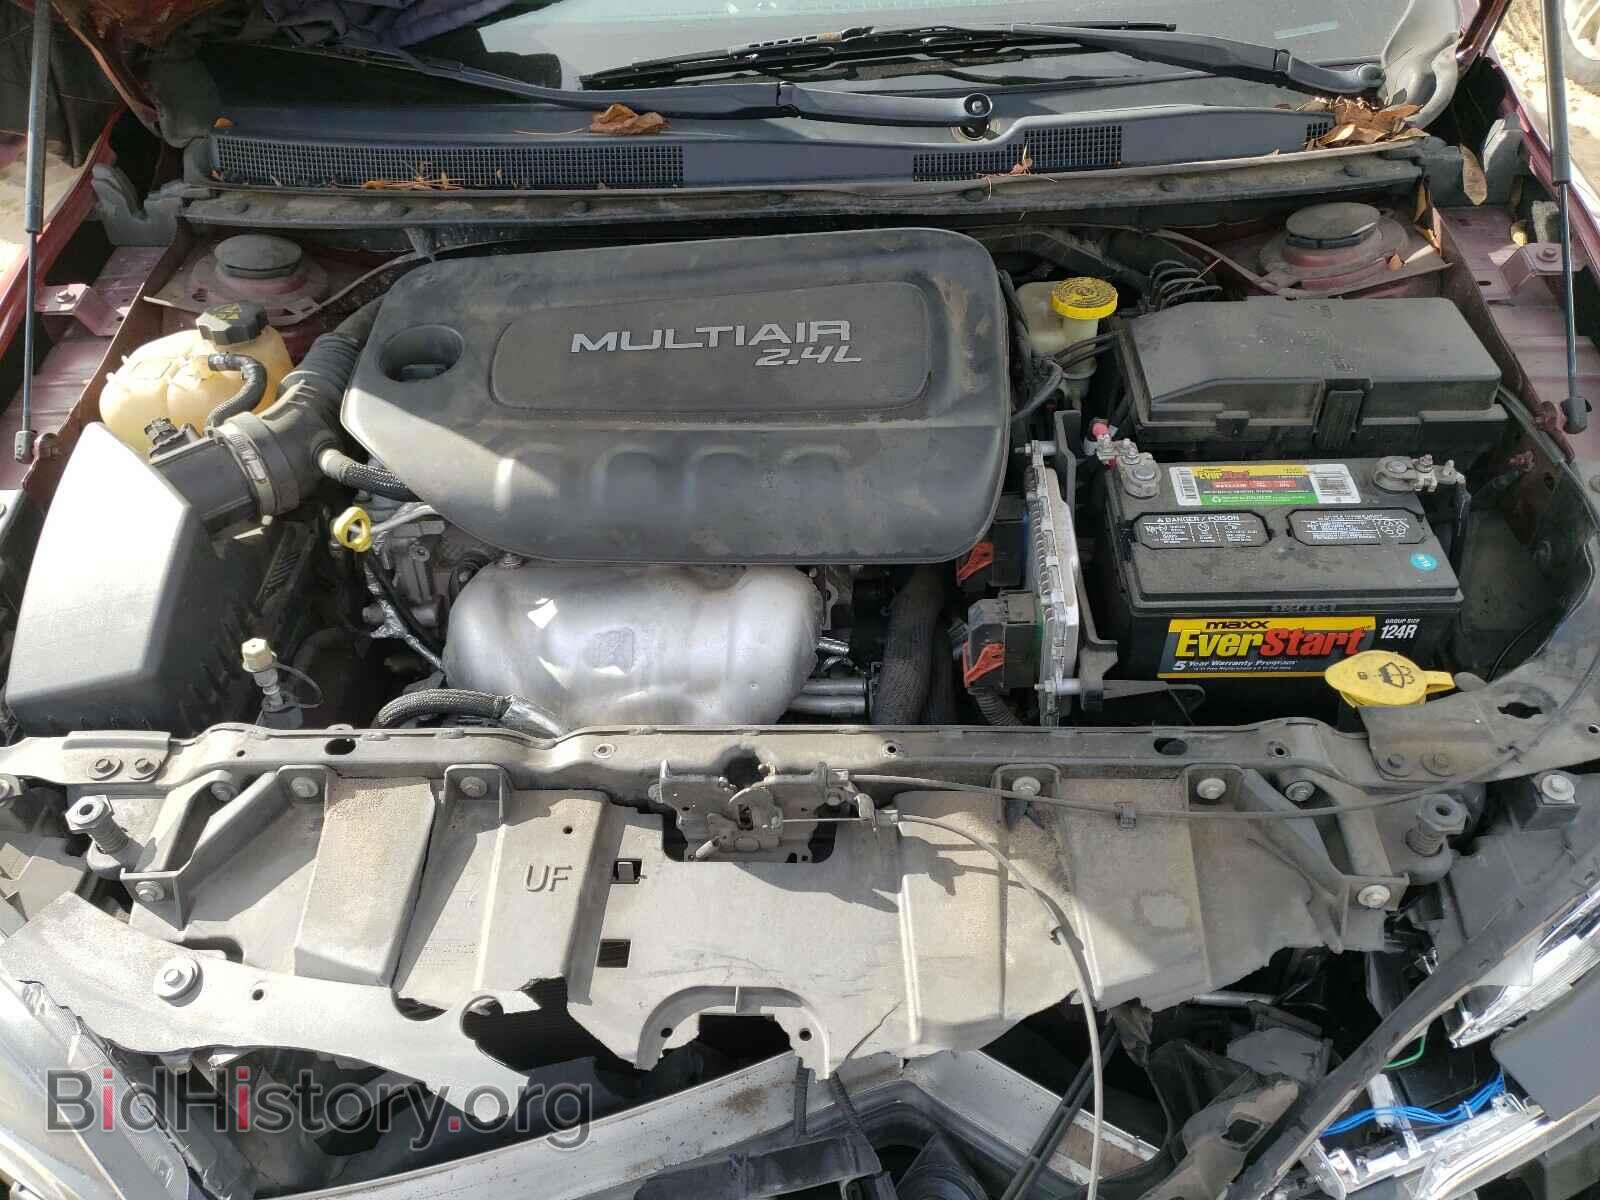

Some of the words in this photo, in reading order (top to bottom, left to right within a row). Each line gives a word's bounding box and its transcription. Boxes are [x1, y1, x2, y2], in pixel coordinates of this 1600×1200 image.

[571, 320, 850, 352] MULTIAIR
[755, 345, 862, 367] 2.4L
[1175, 627, 1366, 657] EverStart
[1381, 624, 1418, 639] 124R
[1172, 661, 1186, 671] 5
[1211, 660, 1253, 668] Warranty
[525, 864, 574, 893] UF
